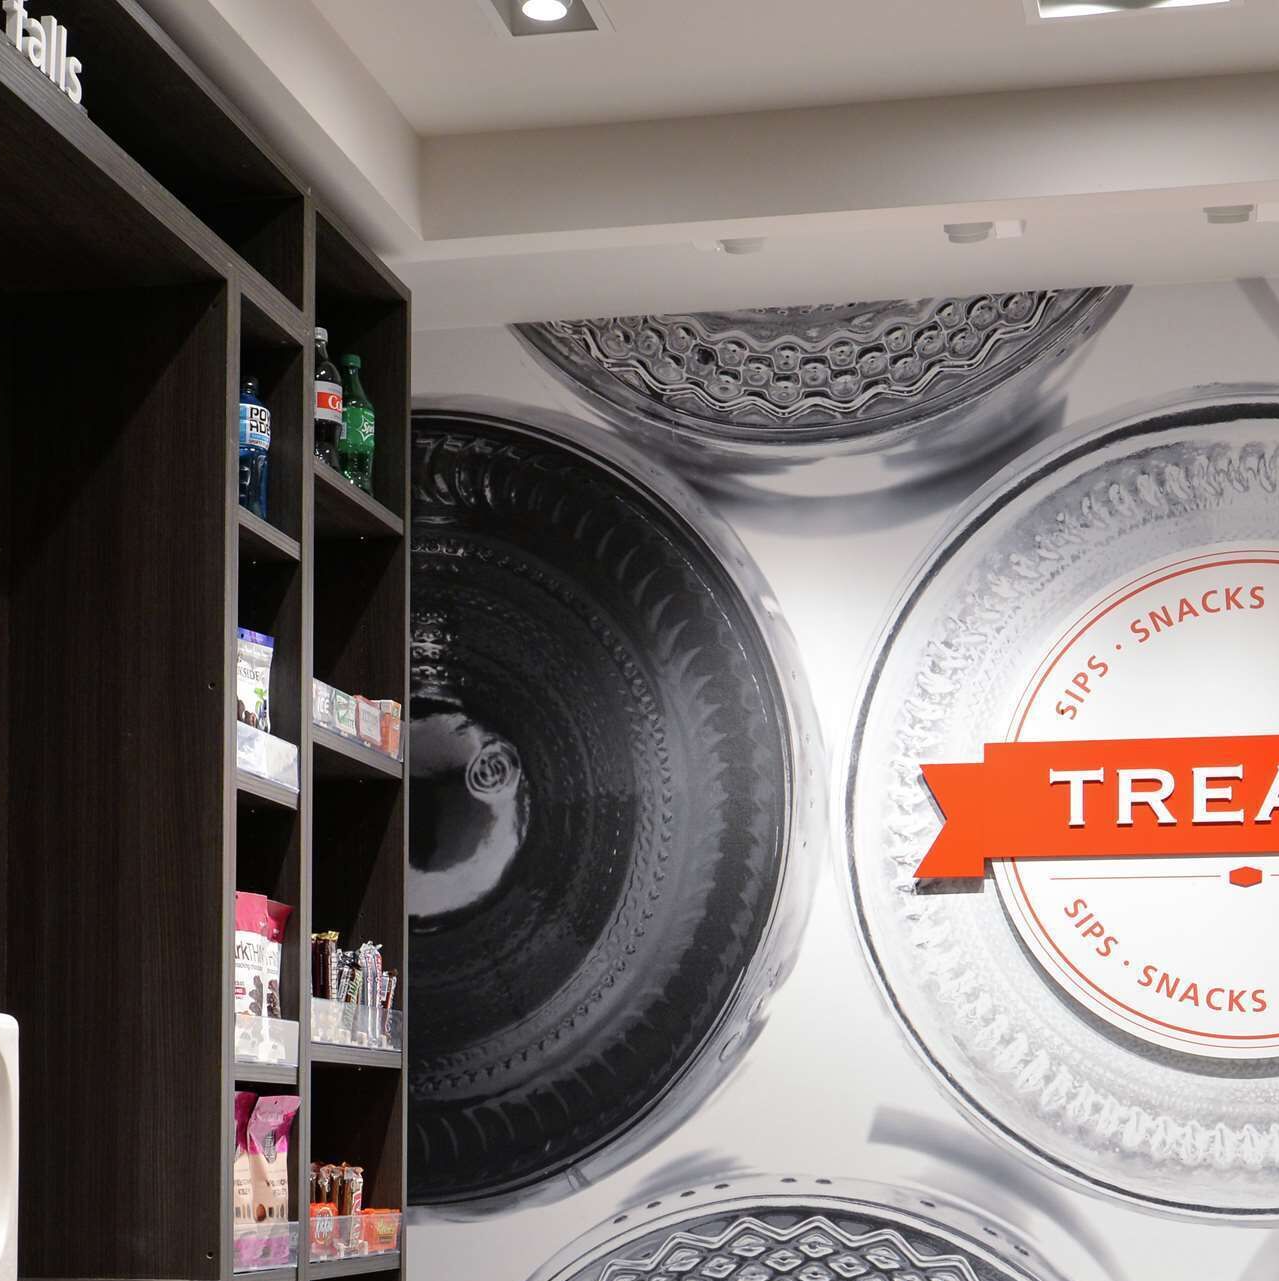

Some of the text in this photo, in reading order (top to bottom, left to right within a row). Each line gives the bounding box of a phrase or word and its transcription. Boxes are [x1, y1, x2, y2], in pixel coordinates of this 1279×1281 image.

[1056, 656, 1109, 720] SIPS
[1130, 585, 1267, 644] SNACKS
[1063, 898, 1118, 959] SIPS
[1137, 964, 1268, 1014] SNACKS
